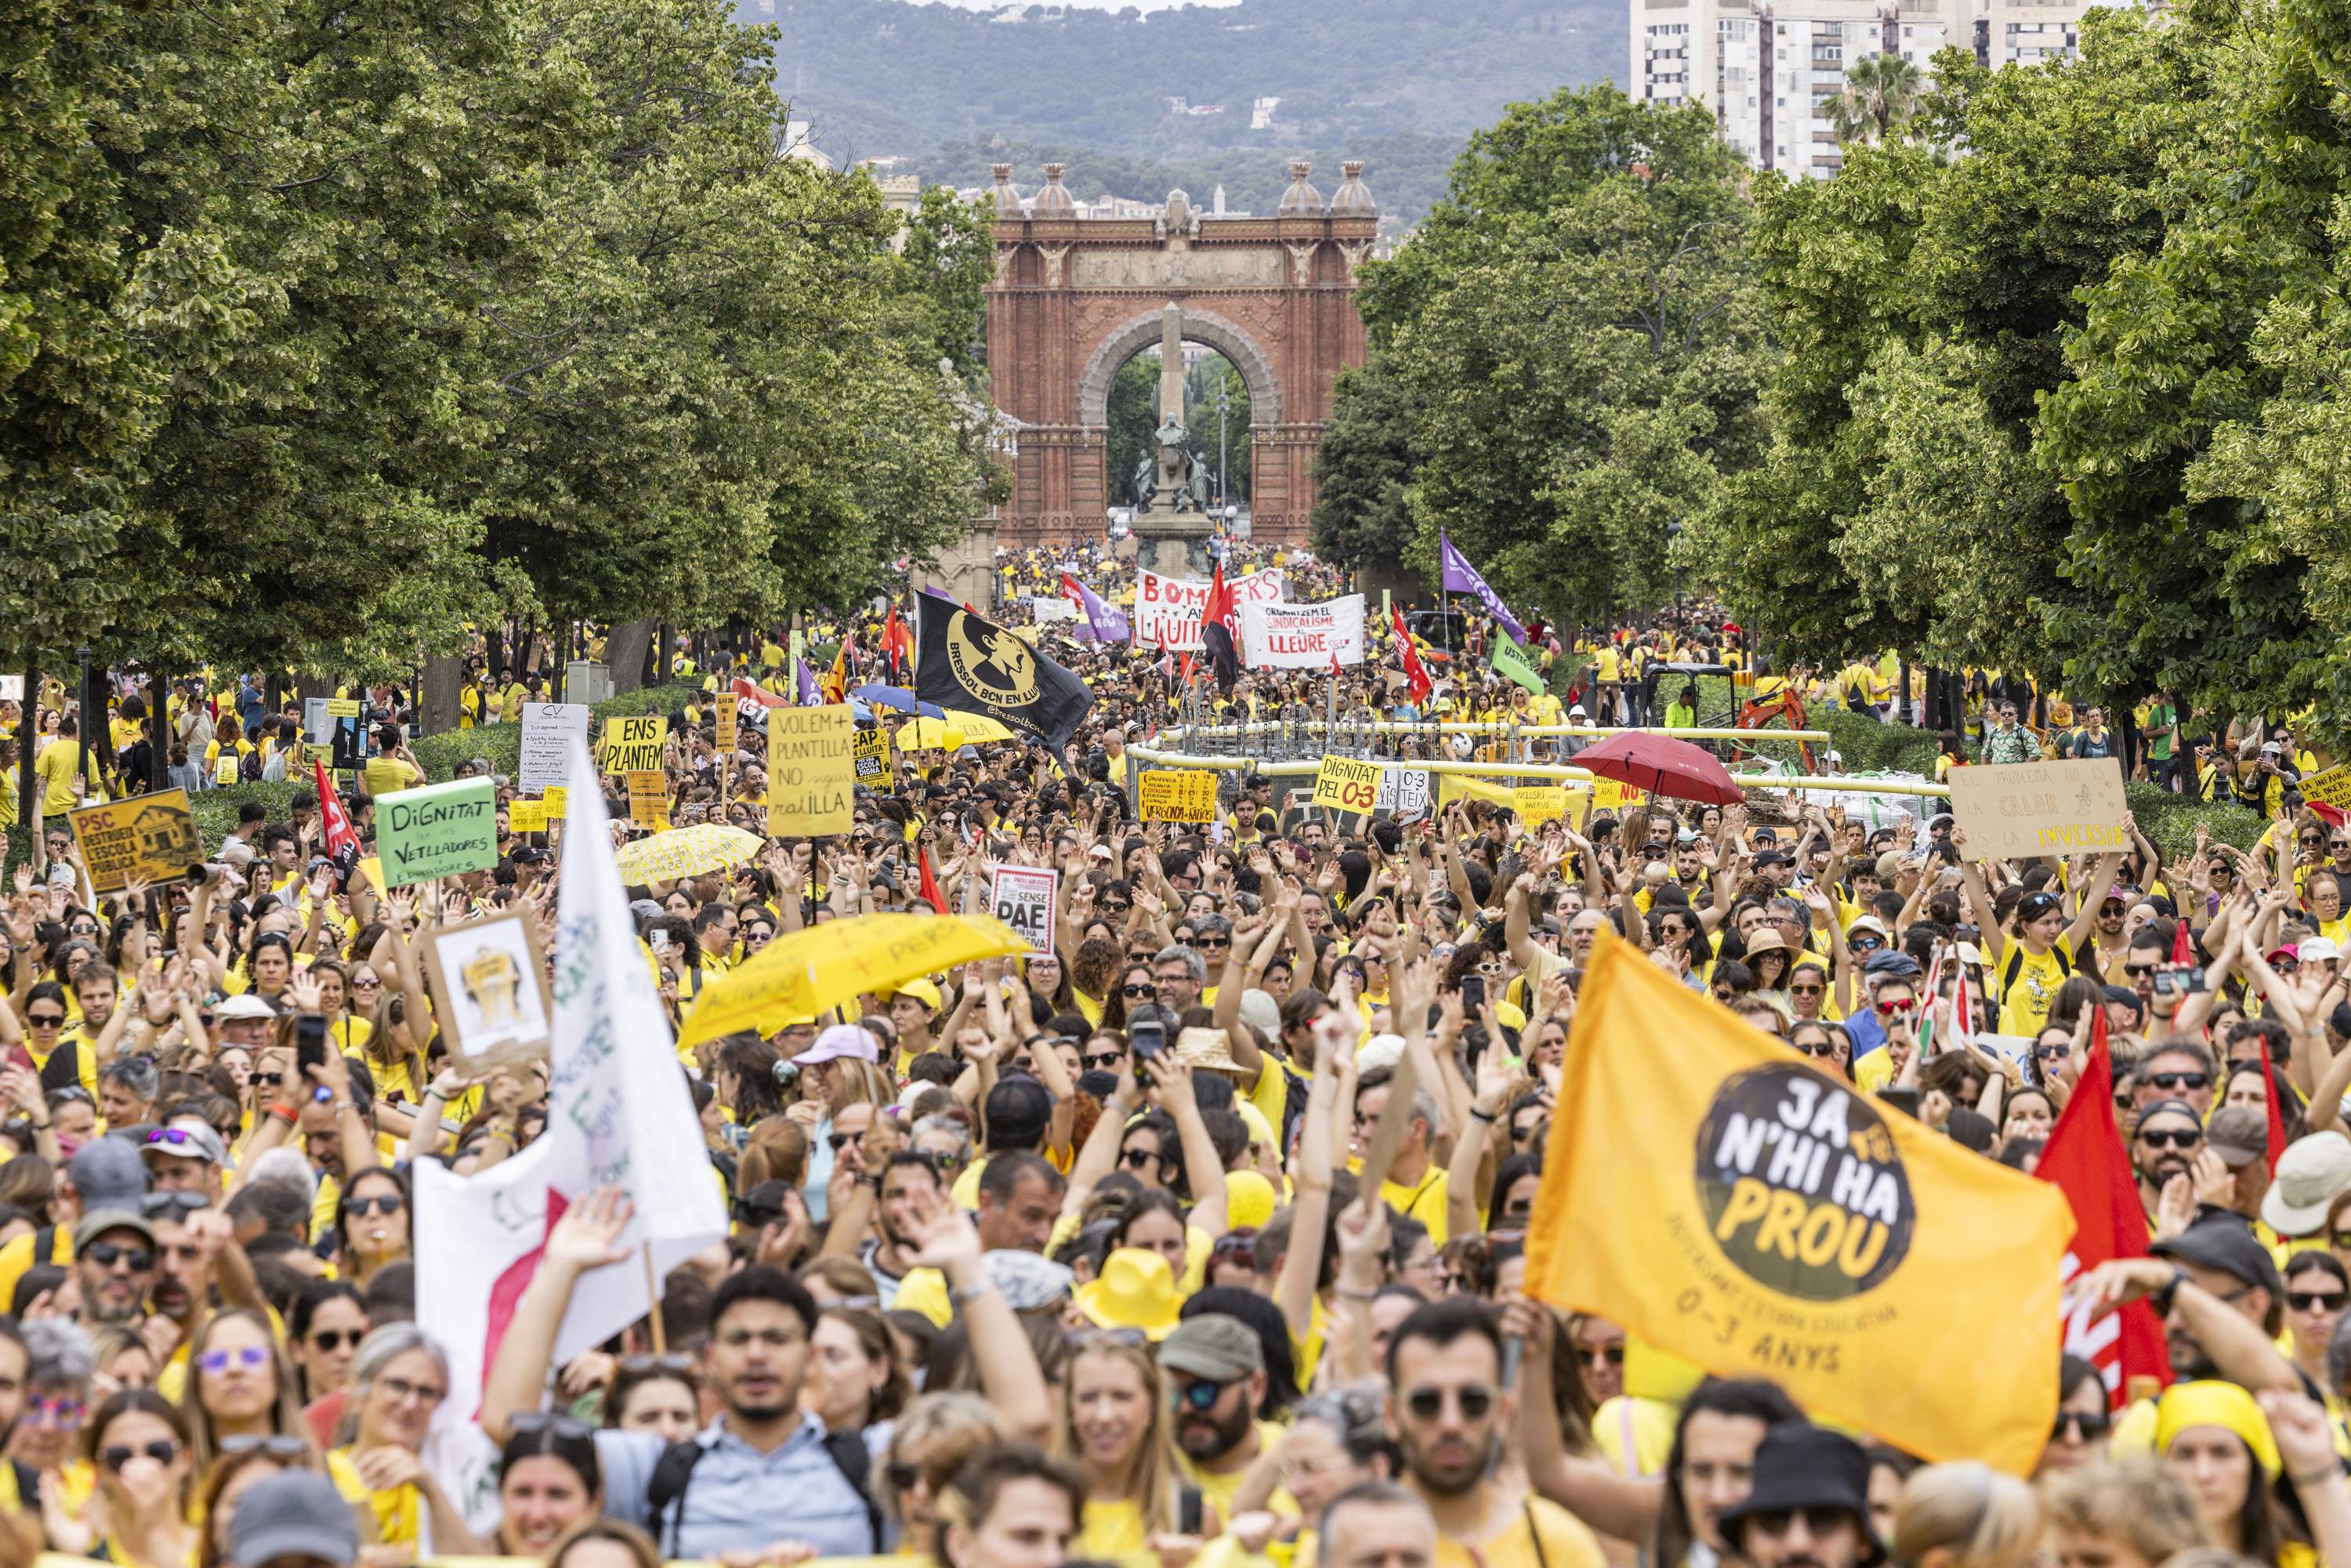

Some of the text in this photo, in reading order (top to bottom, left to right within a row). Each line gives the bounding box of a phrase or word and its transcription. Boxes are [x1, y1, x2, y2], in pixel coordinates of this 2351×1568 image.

[1144, 570, 1280, 607] BOMERS
[1266, 607, 1331, 617] ORGANITZEM EL
[1266, 615, 1336, 629] SINDICALISME
[1268, 633, 1328, 654] LLEURE
[950, 642, 980, 693] BRESSOL
[980, 688, 1003, 704] BCN
[1005, 693, 1022, 704] EN
[542, 704, 563, 716] CV
[737, 696, 771, 724] CGT
[623, 719, 657, 741] ENS
[777, 714, 847, 734] VOLEM +
[605, 742, 664, 772] PLANTEM
[776, 738, 851, 760] PLANTILLA
[860, 744, 884, 756] LLUITA
[857, 760, 880, 770] ESCOLA
[859, 766, 880, 777] DIGNA
[777, 767, 803, 787] NO
[1404, 771, 1425, 788] 0-3
[1961, 773, 1981, 788] EL
[1993, 769, 2052, 785] PROBLEMA
[2063, 766, 2081, 782] NO
[2300, 782, 2313, 792] LA
[1317, 779, 1375, 809] PEL 0-3
[1620, 784, 1640, 801] NO
[2309, 787, 2322, 799] TÉ
[1966, 792, 2059, 817] LA CALOR
[77, 811, 115, 834] PSC
[82, 826, 136, 848] DESTRUEIX
[2002, 830, 2021, 847] LA
[86, 839, 138, 861] L'ESCOLA
[394, 837, 489, 865] VETLLADORES
[1018, 892, 1048, 904] SENSE
[997, 900, 1046, 930] PAE
[1027, 929, 1038, 938] HA
[1777, 1076, 1851, 1149] JA
[1714, 1111, 1900, 1226] N'HI HA
[1714, 1177, 1890, 1280] PROU
[1675, 1286, 1843, 1374] 0-3 ANYS
